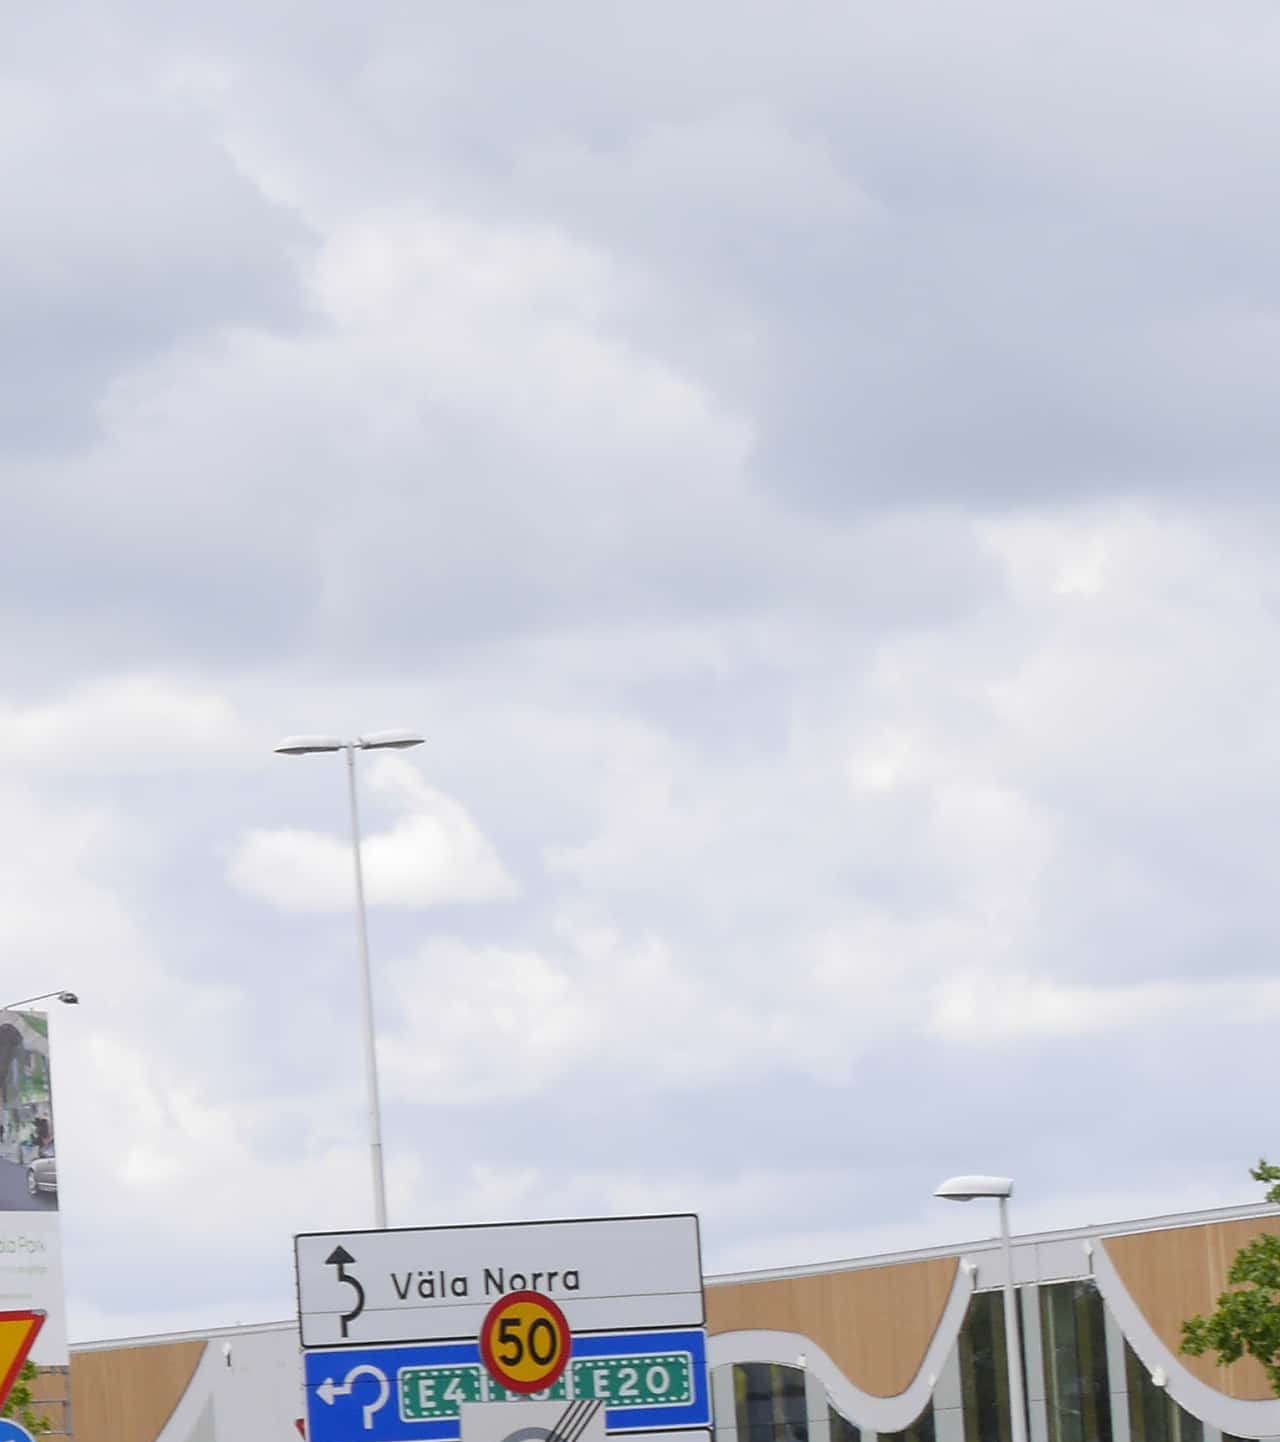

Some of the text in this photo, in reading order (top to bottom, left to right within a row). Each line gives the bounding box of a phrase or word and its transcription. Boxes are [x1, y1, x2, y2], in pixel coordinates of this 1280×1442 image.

[391, 1267, 581, 1300] Väla Norra
[497, 1317, 558, 1367] 50
[418, 1377, 467, 1409] E4
[593, 1366, 671, 1399] E20
